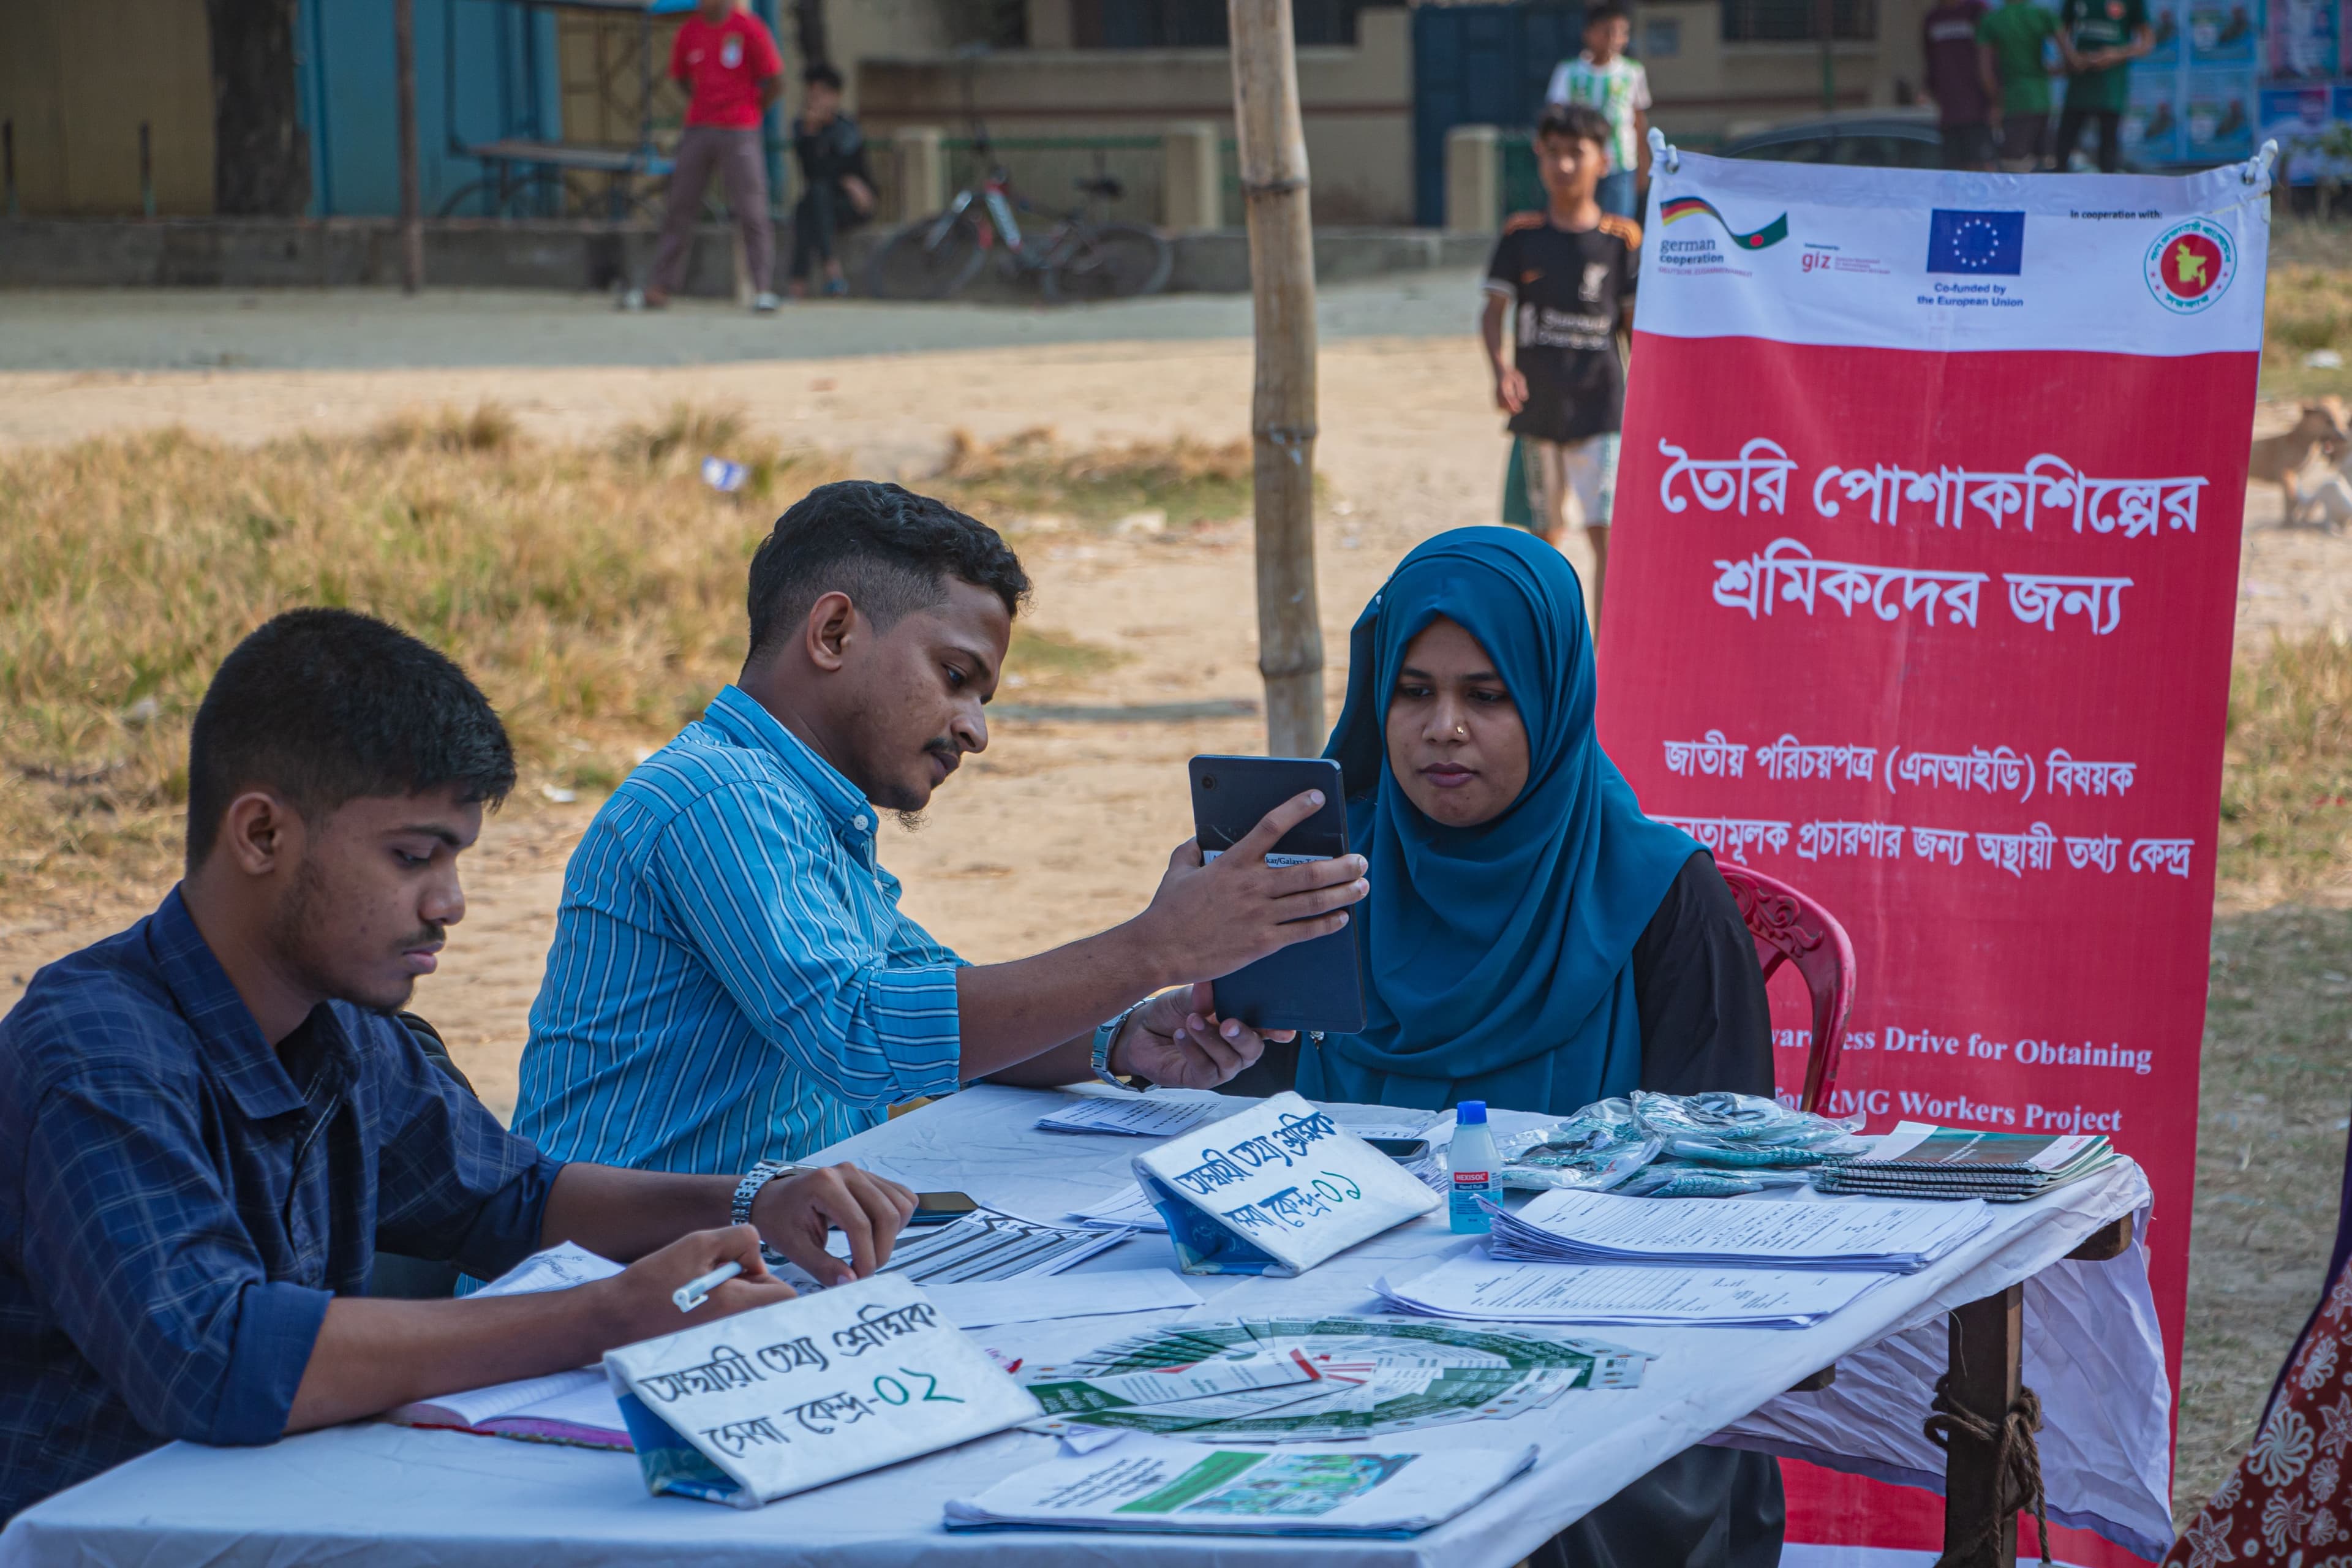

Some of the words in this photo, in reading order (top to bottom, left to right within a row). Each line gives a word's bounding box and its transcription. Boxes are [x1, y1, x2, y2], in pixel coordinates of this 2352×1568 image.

[2070, 210, 2079, 219] In
[2082, 211, 2136, 221] cooperation
[2138, 210, 2163, 219] with:
[1659, 252, 1724, 266] cooperation
[1660, 239, 1716, 254] german
[1802, 251, 1831, 273] giz
[1917, 295, 1934, 304] the
[1937, 296, 1989, 307] European
[1992, 298, 2024, 307] Union
[1934, 282, 1990, 293] Co-funded
[1993, 284, 2007, 295] by
[1658, 437, 1798, 516] তৈরি
[1812, 453, 2209, 538] পোশাকশিল্পের
[1713, 537, 1990, 628] শ্রমিকদের
[2002, 573, 2134, 635] জন্য
[1663, 729, 1749, 778] জাতীয়
[1884, 744, 2036, 803] (এনআইডি)
[1796, 818, 1905, 862] প্রচারণার
[1912, 826, 1969, 865] জন্য
[2064, 834, 2122, 874] তথ্য
[2128, 839, 2195, 878] কেন্দ্র
[1884, 1027, 1959, 1055] Drive
[1968, 1033, 2008, 1060] for
[2015, 1039, 2152, 1074] Obtaining
[1900, 1091, 2015, 1126] Workers
[2024, 1104, 2122, 1135] Project
